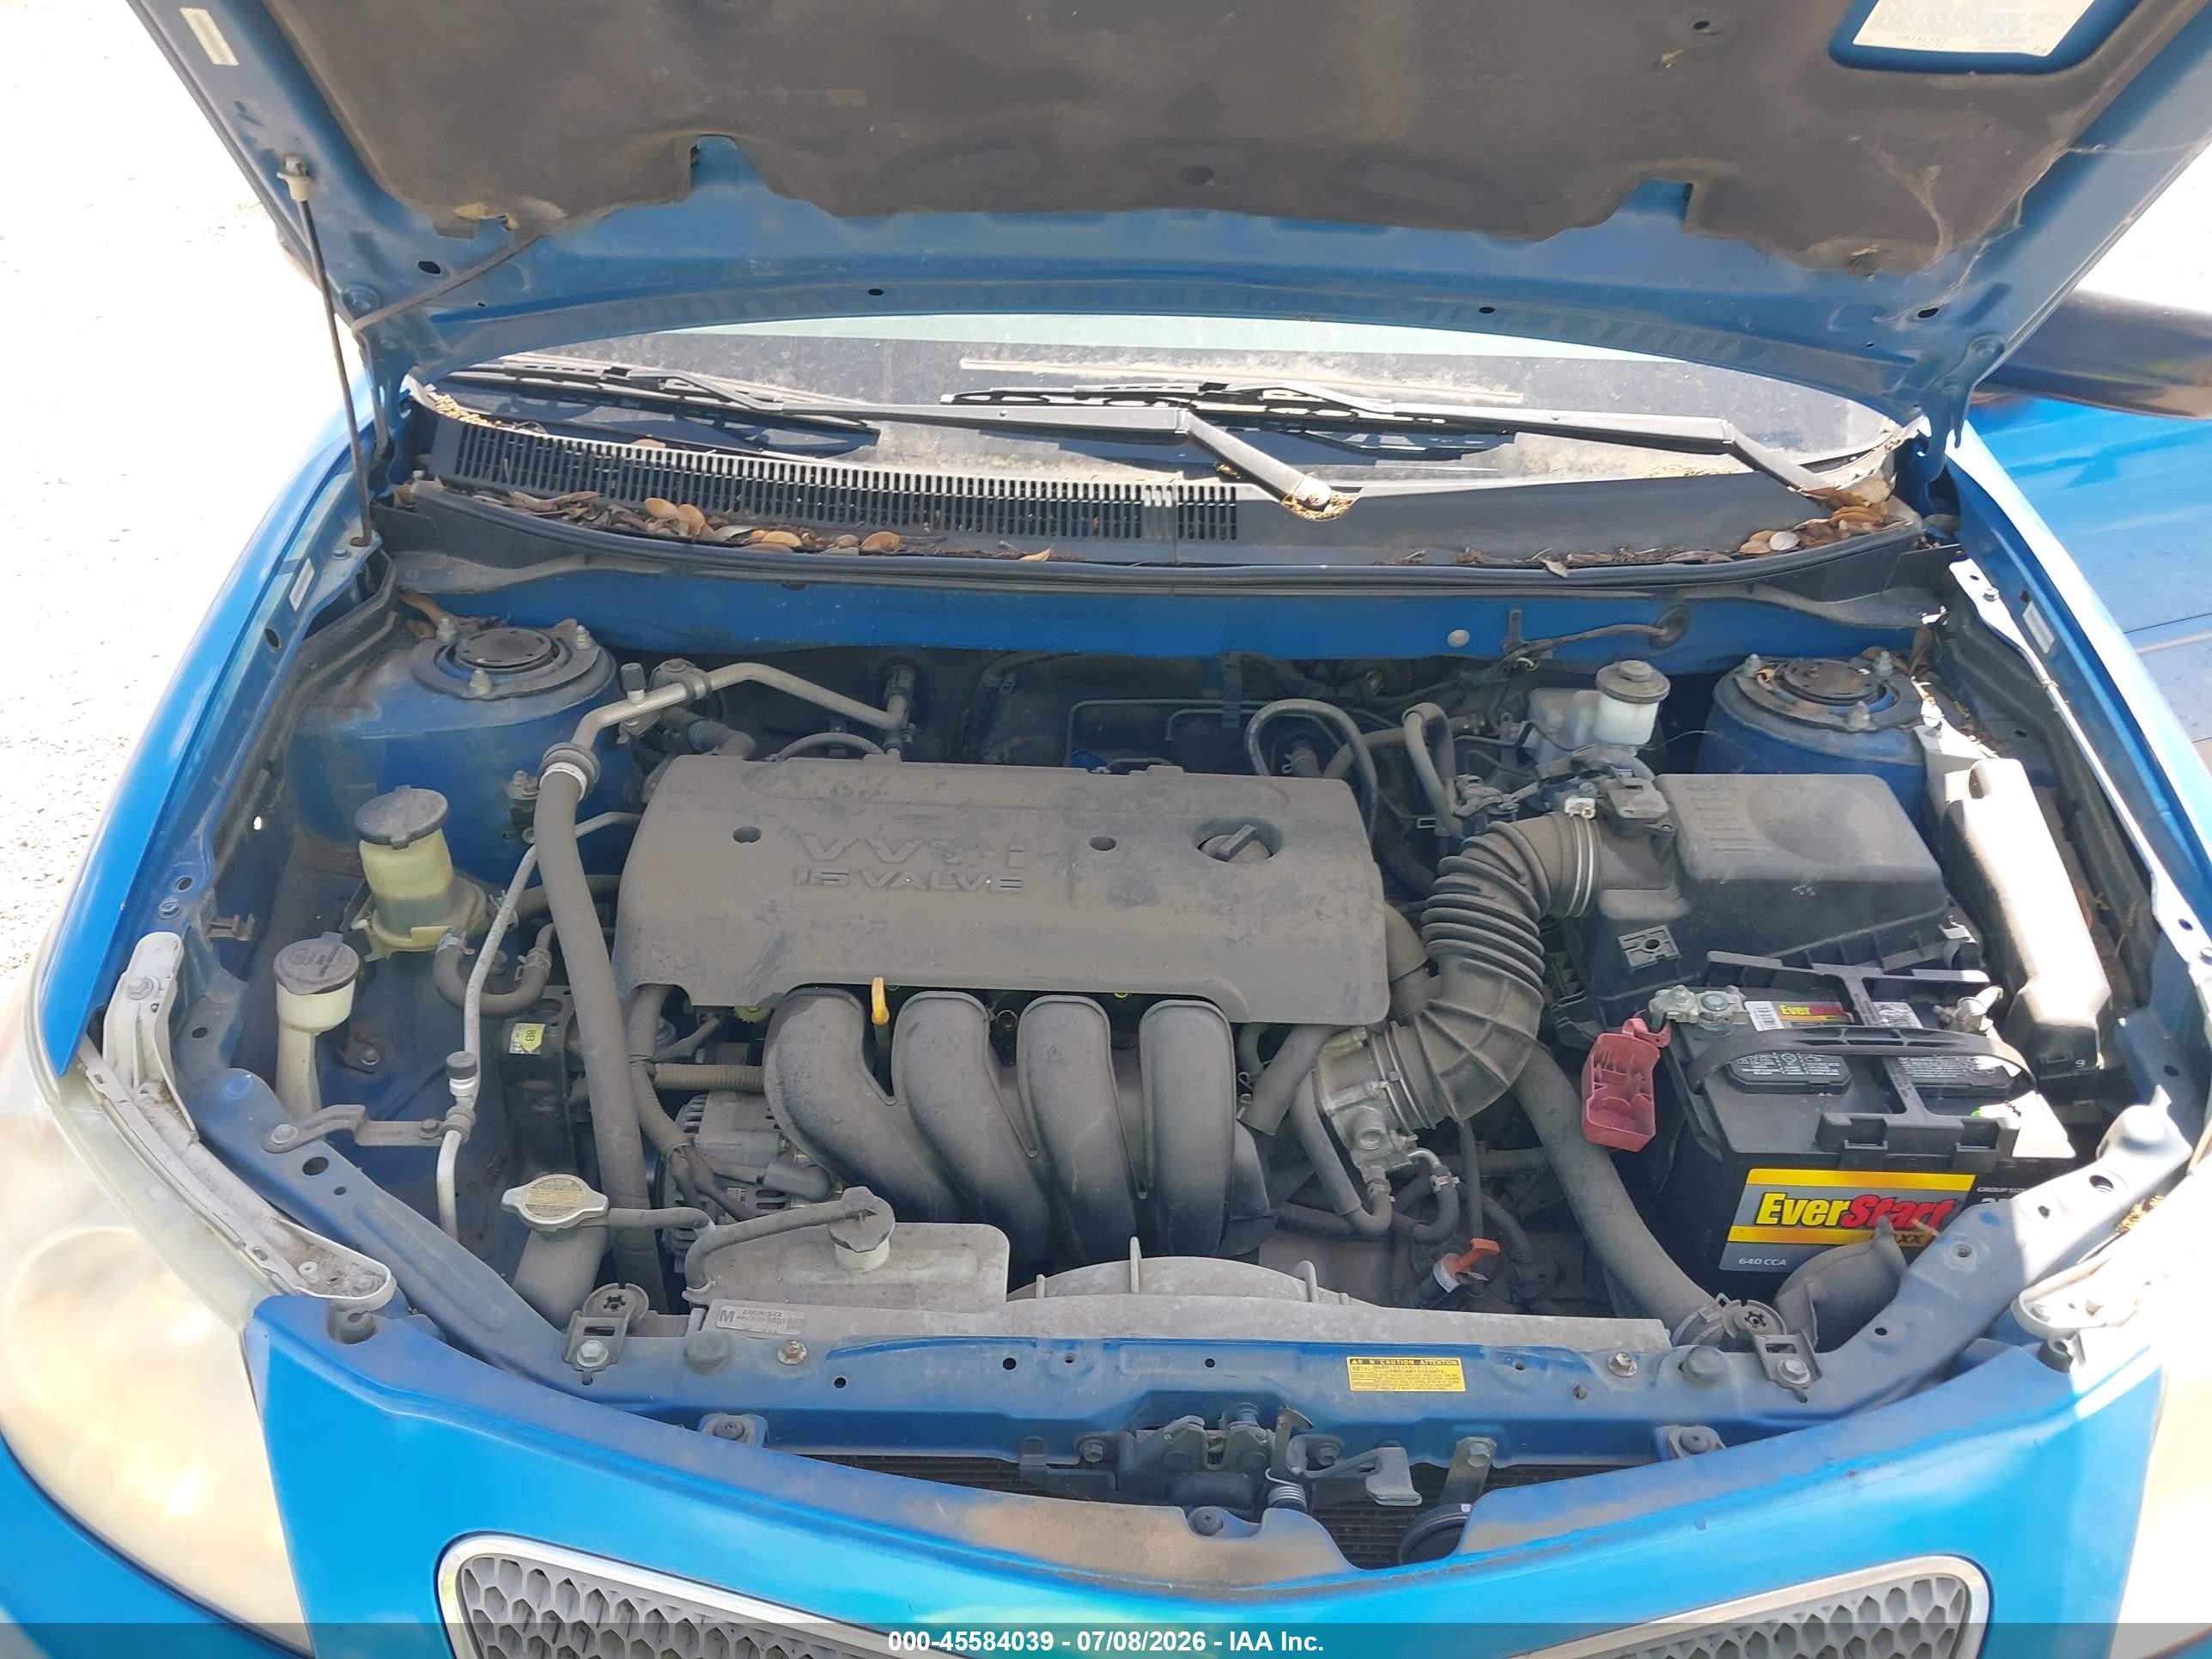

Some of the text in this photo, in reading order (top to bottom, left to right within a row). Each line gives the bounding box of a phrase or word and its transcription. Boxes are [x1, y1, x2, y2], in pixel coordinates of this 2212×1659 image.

[793, 866, 1024, 892] 16 VALVE
[1755, 1192, 1956, 1231] EverStart
[1738, 1256, 1787, 1267] 640 CCA
[719, 1310, 735, 1322] M
